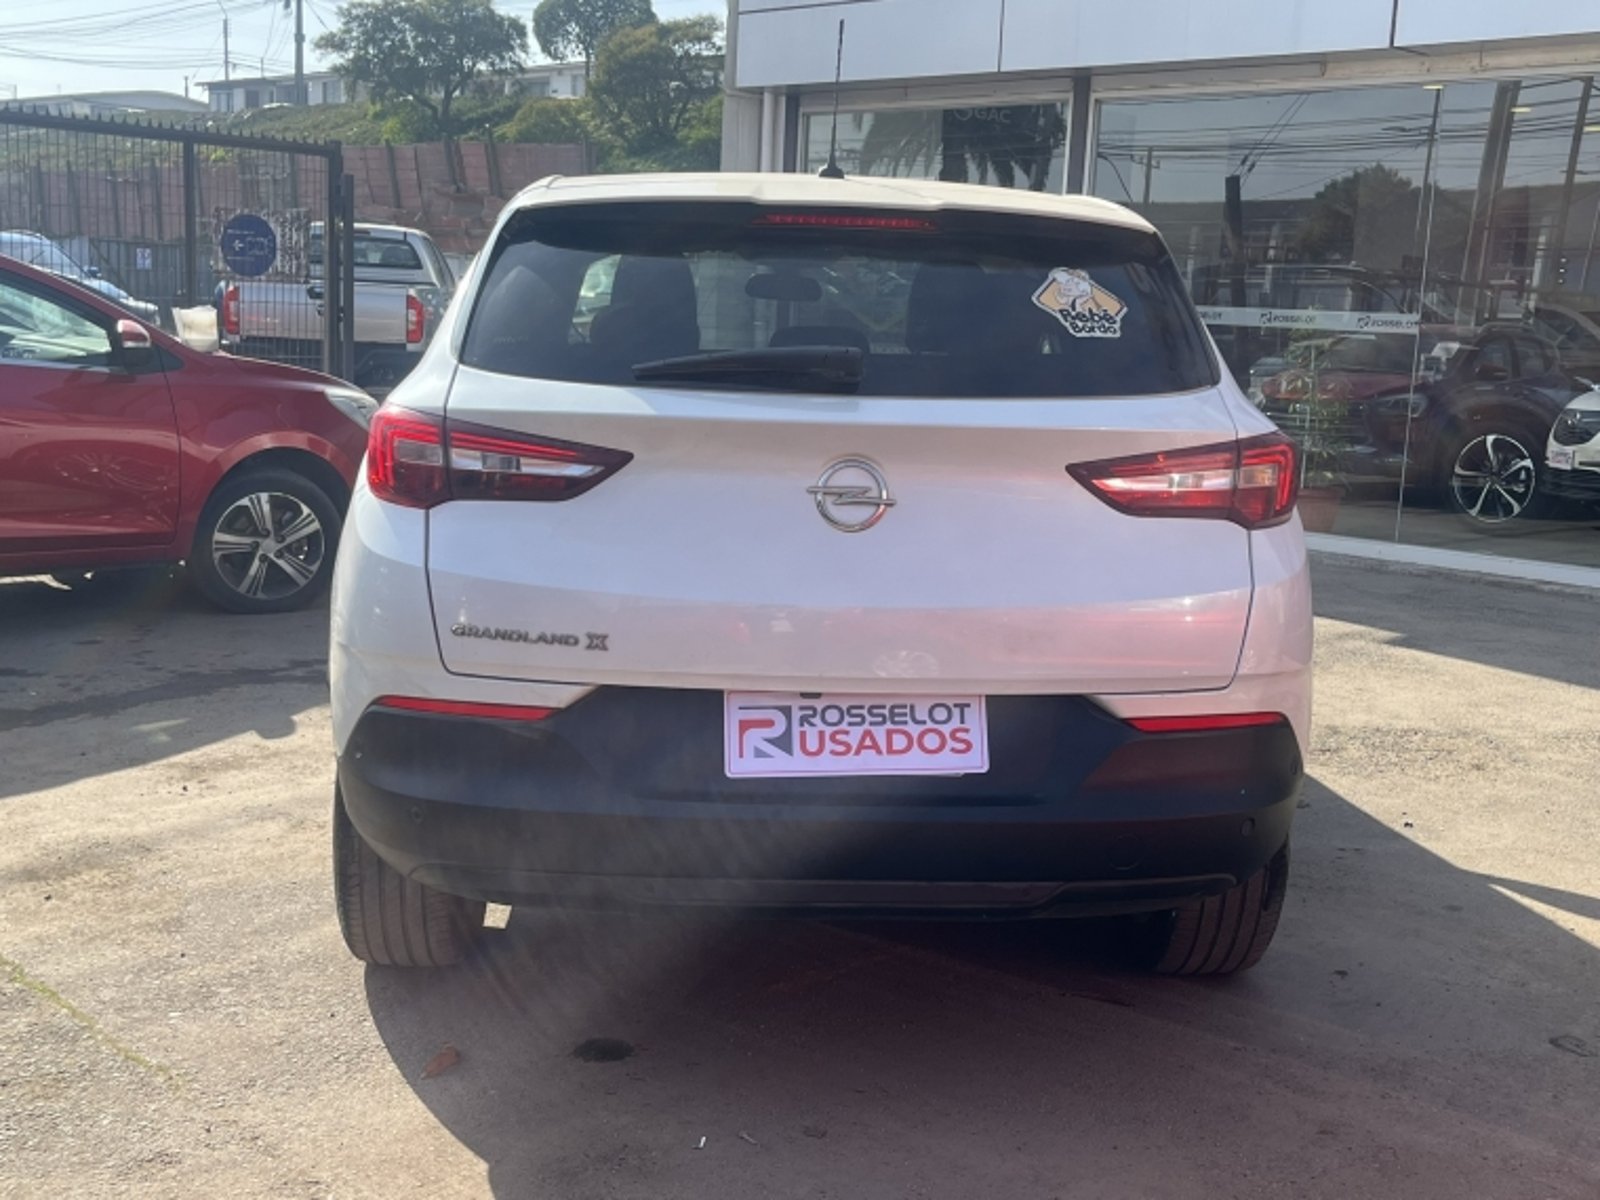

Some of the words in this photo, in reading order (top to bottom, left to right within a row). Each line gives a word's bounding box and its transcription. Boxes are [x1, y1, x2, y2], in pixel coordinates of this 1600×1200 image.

[451, 623, 580, 647] GRANDLAND
[585, 632, 609, 651] X
[798, 702, 971, 727] ROSSELOT
[800, 727, 974, 757] USADOS
